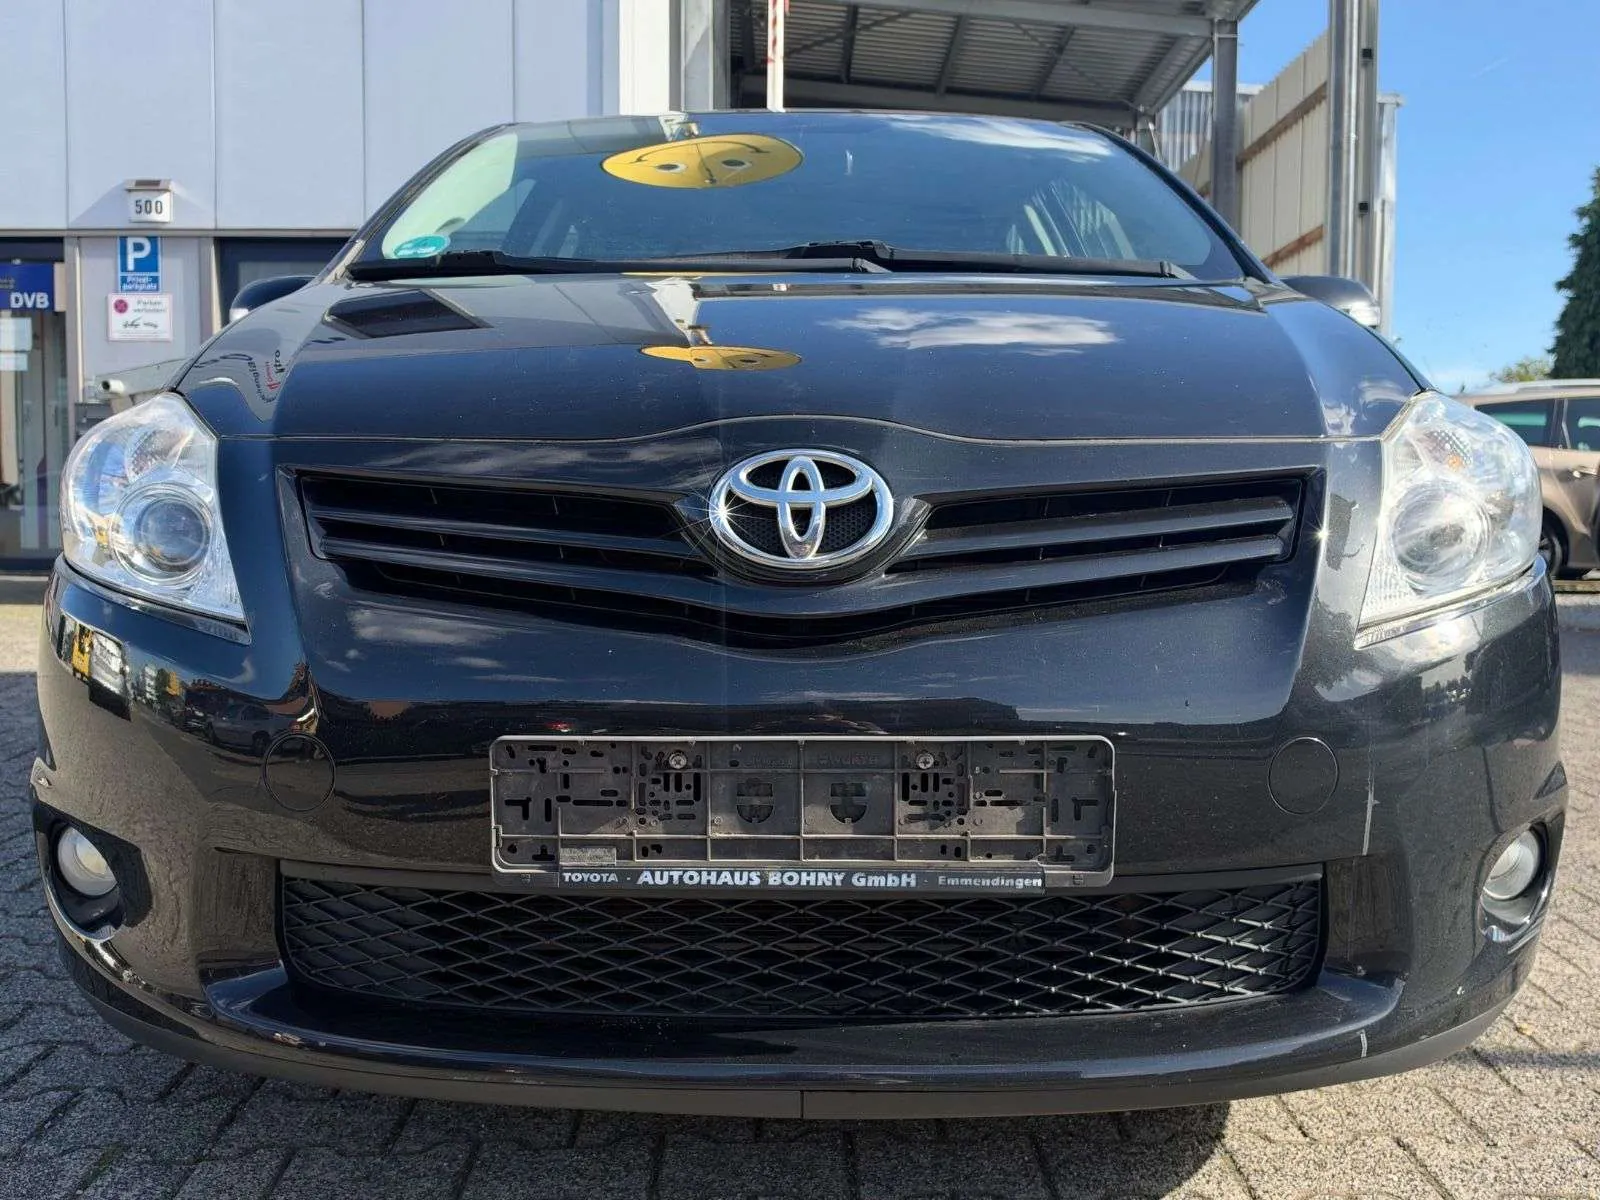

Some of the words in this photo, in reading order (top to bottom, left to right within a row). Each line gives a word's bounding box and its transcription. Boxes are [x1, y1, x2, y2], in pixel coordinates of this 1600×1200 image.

[135, 200, 163, 215] 500
[126, 237, 151, 271] P
[10, 292, 50, 309] DVB
[562, 872, 619, 883] TOYOTA
[636, 870, 761, 886] AUTOHAUS
[767, 871, 845, 888] BOHNY
[851, 872, 917, 888] GmbH
[937, 876, 1042, 889] Emmendingen
